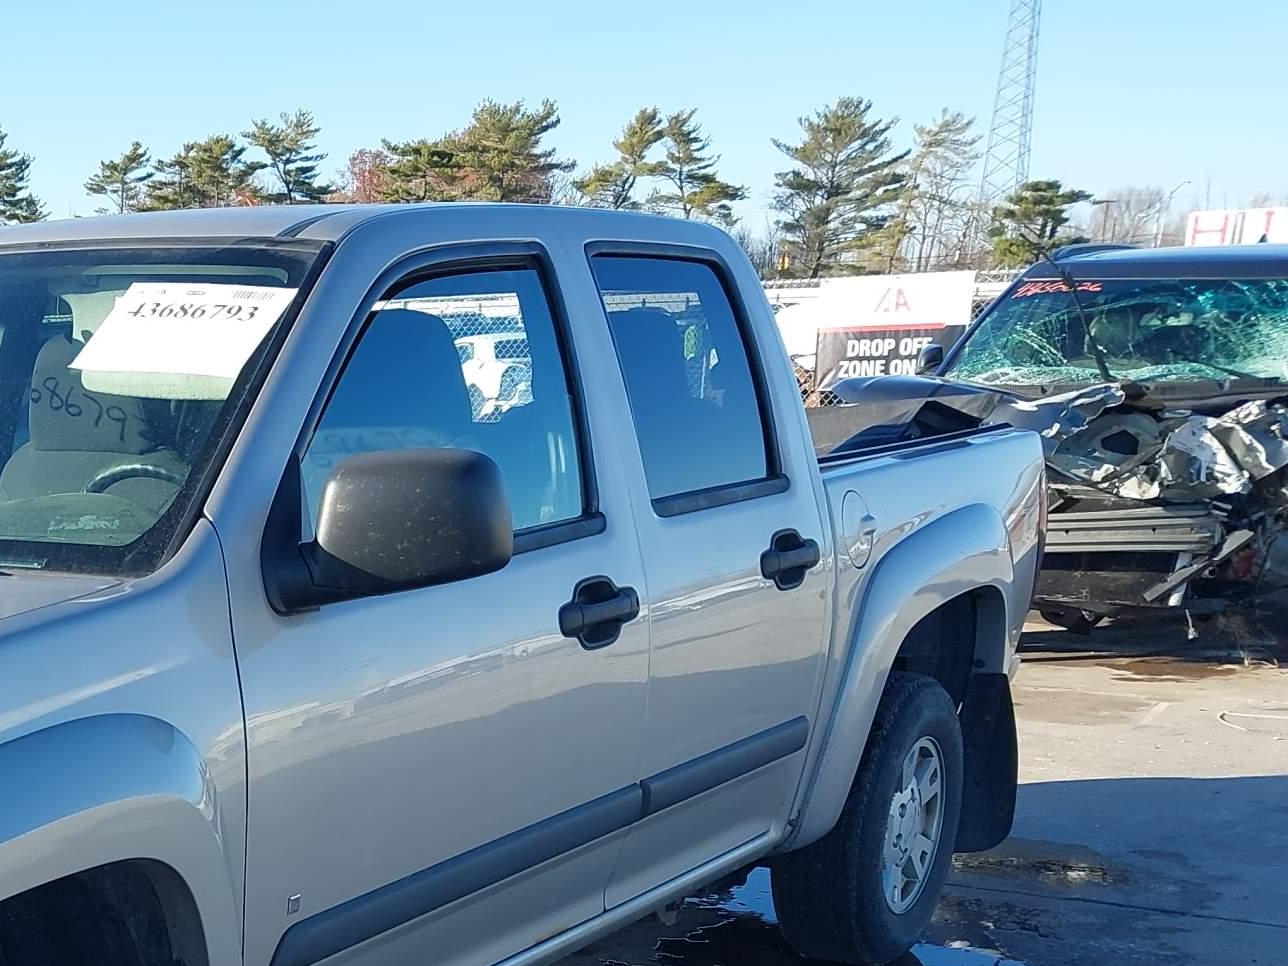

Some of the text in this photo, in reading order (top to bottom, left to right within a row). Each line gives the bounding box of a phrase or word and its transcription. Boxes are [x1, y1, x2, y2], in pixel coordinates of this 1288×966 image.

[128, 302, 259, 321] 43686793
[846, 336, 933, 358] DROP OFF
[838, 359, 886, 378] ZONE
